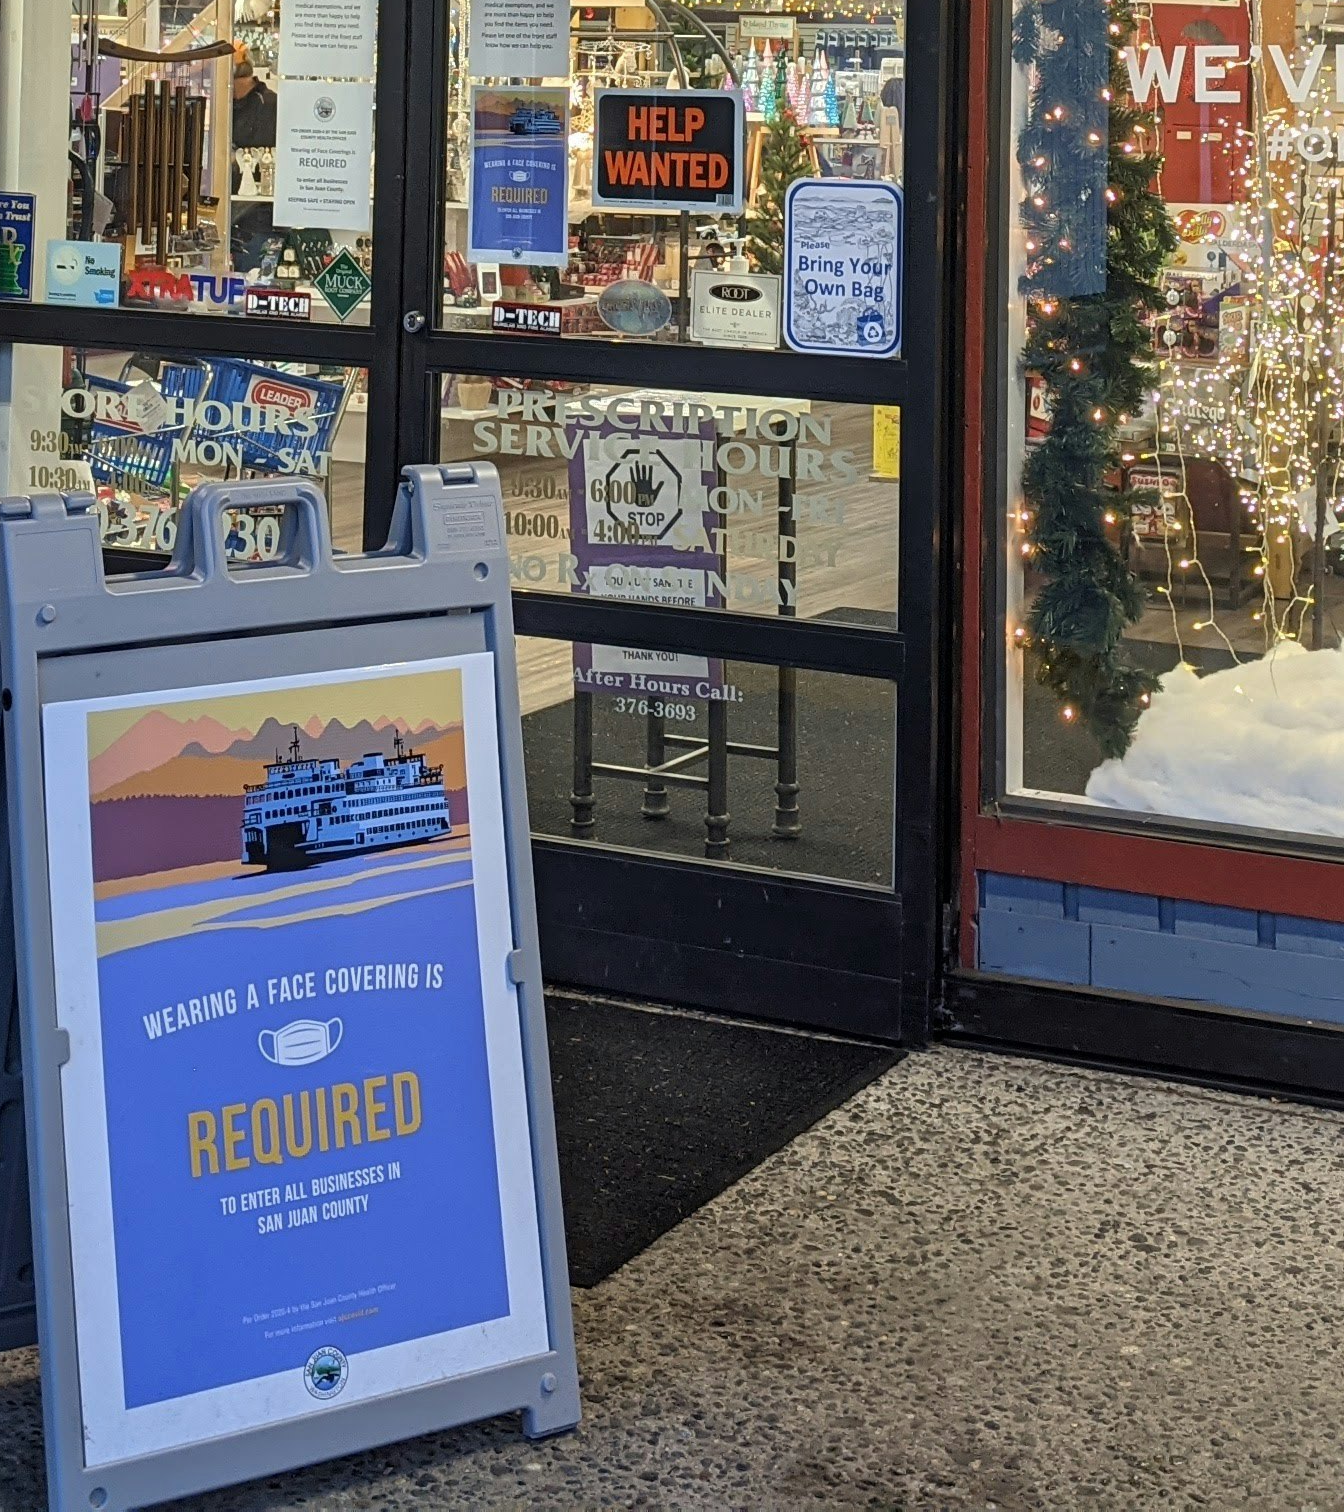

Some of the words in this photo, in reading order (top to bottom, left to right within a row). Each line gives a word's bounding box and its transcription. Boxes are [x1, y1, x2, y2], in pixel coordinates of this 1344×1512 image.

[628, 105, 705, 143] HELP
[299, 158, 347, 168] REQUIRED
[605, 150, 729, 189] WANTED
[11, 200, 29, 210] You
[492, 186, 548, 204] REQUIRED
[6, 211, 31, 222] Trust
[800, 240, 830, 250] Please
[85, 256, 95, 264] No
[798, 255, 844, 277] Bring
[849, 256, 892, 277] Your
[85, 267, 116, 278] Smoking
[325, 274, 363, 289] MUCK
[720, 286, 750, 300] ROOT
[805, 278, 846, 296] Own
[851, 281, 884, 303] Bag
[248, 294, 309, 313] D-TECH
[699, 305, 727, 316] ELITE
[731, 308, 772, 319] DEALER
[494, 306, 560, 328] D-TECH
[259, 388, 303, 408] LEADER
[166, 397, 319, 438] HOURS
[496, 389, 833, 446] PRESCRIPTION
[170, 438, 244, 468] MON
[277, 447, 333, 477] SAT
[472, 421, 663, 467] SERVICE
[684, 439, 858, 485] HOURS
[628, 512, 665, 526] STOP
[622, 650, 654, 662] THANK
[656, 652, 679, 662] YOU!
[574, 667, 624, 688] After
[629, 673, 690, 696] Hours
[695, 682, 744, 703] Call:
[615, 697, 696, 721] 376-3693
[142, 989, 238, 1041] WEARING
[246, 983, 260, 1009] A
[267, 971, 317, 1005] FACE
[325, 963, 420, 994] COVERING
[424, 963, 444, 989] IS
[187, 1070, 423, 1178] REQUIRED
[220, 1196, 237, 1217] TO
[240, 1187, 281, 1213] ENTER
[284, 1182, 308, 1203] ALL
[312, 1166, 384, 1197] BUSINESSES
[387, 1162, 401, 1181] IN
[257, 1215, 284, 1235] SAN
[287, 1206, 318, 1230] JUAN
[322, 1195, 370, 1221] COUNTY
